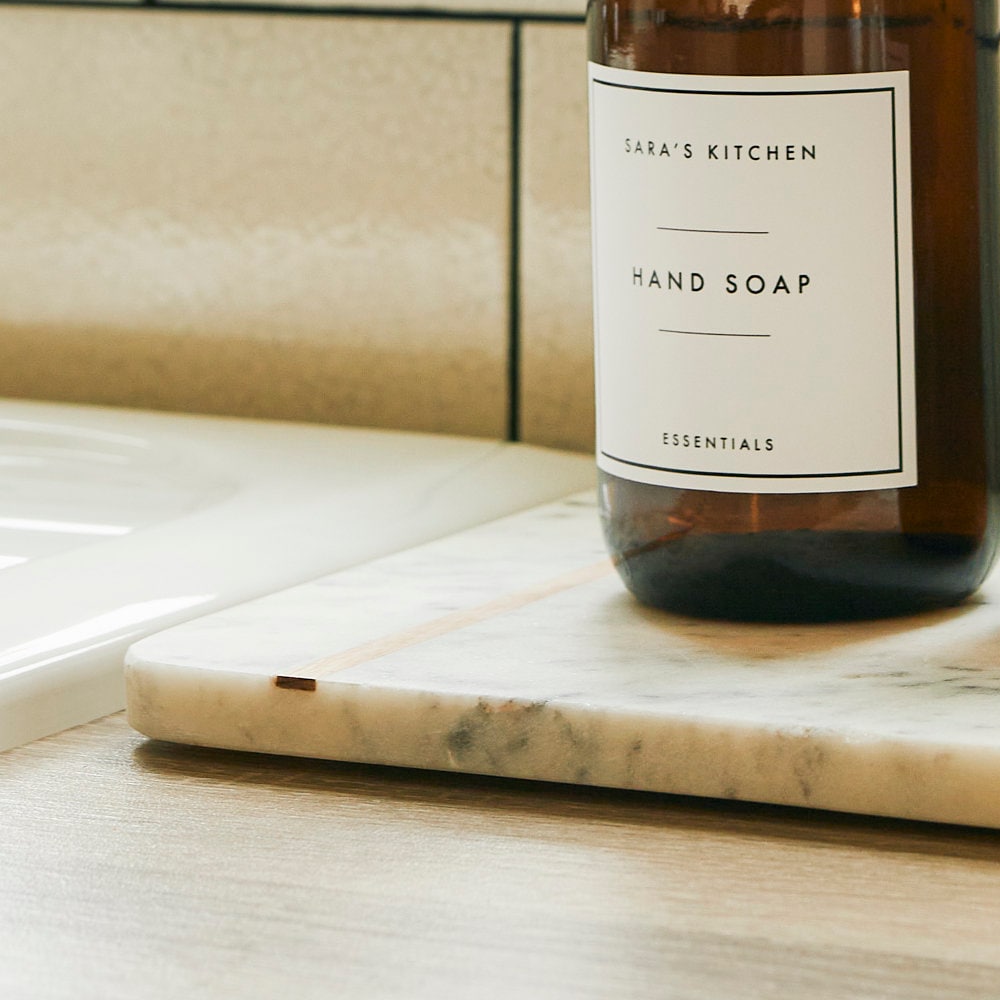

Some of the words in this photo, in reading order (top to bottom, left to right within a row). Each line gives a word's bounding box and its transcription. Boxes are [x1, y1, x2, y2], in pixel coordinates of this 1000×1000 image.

[624, 137, 694, 159] SARA'S
[707, 143, 817, 162] KITCHEN
[631, 266, 706, 294] HAND
[724, 273, 812, 295] SOAP
[662, 431, 775, 453] ESSENTIALS
